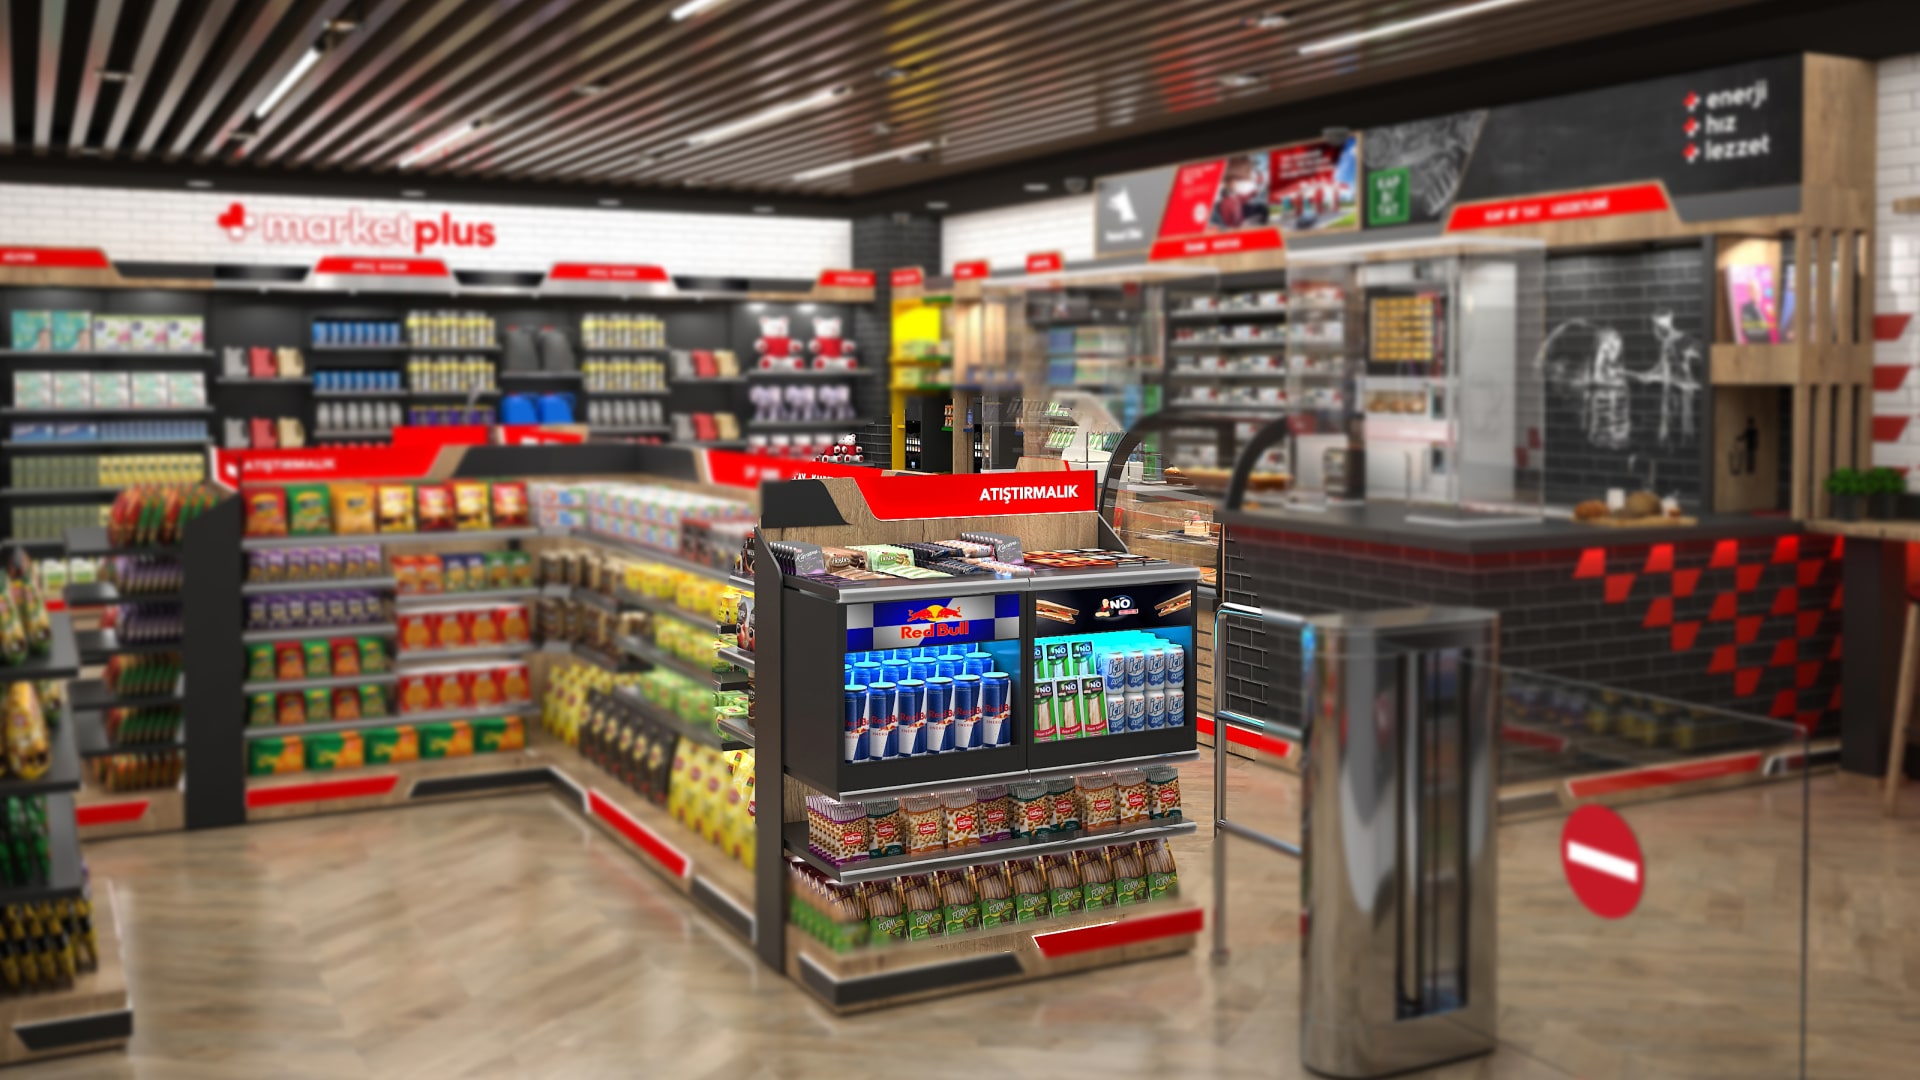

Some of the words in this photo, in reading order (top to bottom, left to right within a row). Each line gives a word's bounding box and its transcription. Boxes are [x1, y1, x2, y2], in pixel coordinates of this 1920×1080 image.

[1706, 79, 1767, 109] enerji
[1705, 134, 1769, 160] lezzet
[980, 485, 1079, 504] ATIŞTIRMALIK
[901, 624, 934, 639] Red
[937, 621, 969, 637] Bull
[929, 709, 946, 718] Red
[957, 707, 974, 715] Red
[985, 704, 1003, 712] Red
[872, 715, 889, 724] Red
[900, 712, 918, 721] Red
[1123, 880, 1139, 892] FORM
[1155, 875, 1170, 888] FORM
[1058, 891, 1074, 904] FORM
[1091, 885, 1106, 898] FORM
[988, 902, 1005, 915] FORM
[1023, 895, 1039, 909] FORM
[952, 907, 968, 920] FORM
[878, 919, 896, 932] FORM
[916, 914, 933, 927] FORM
